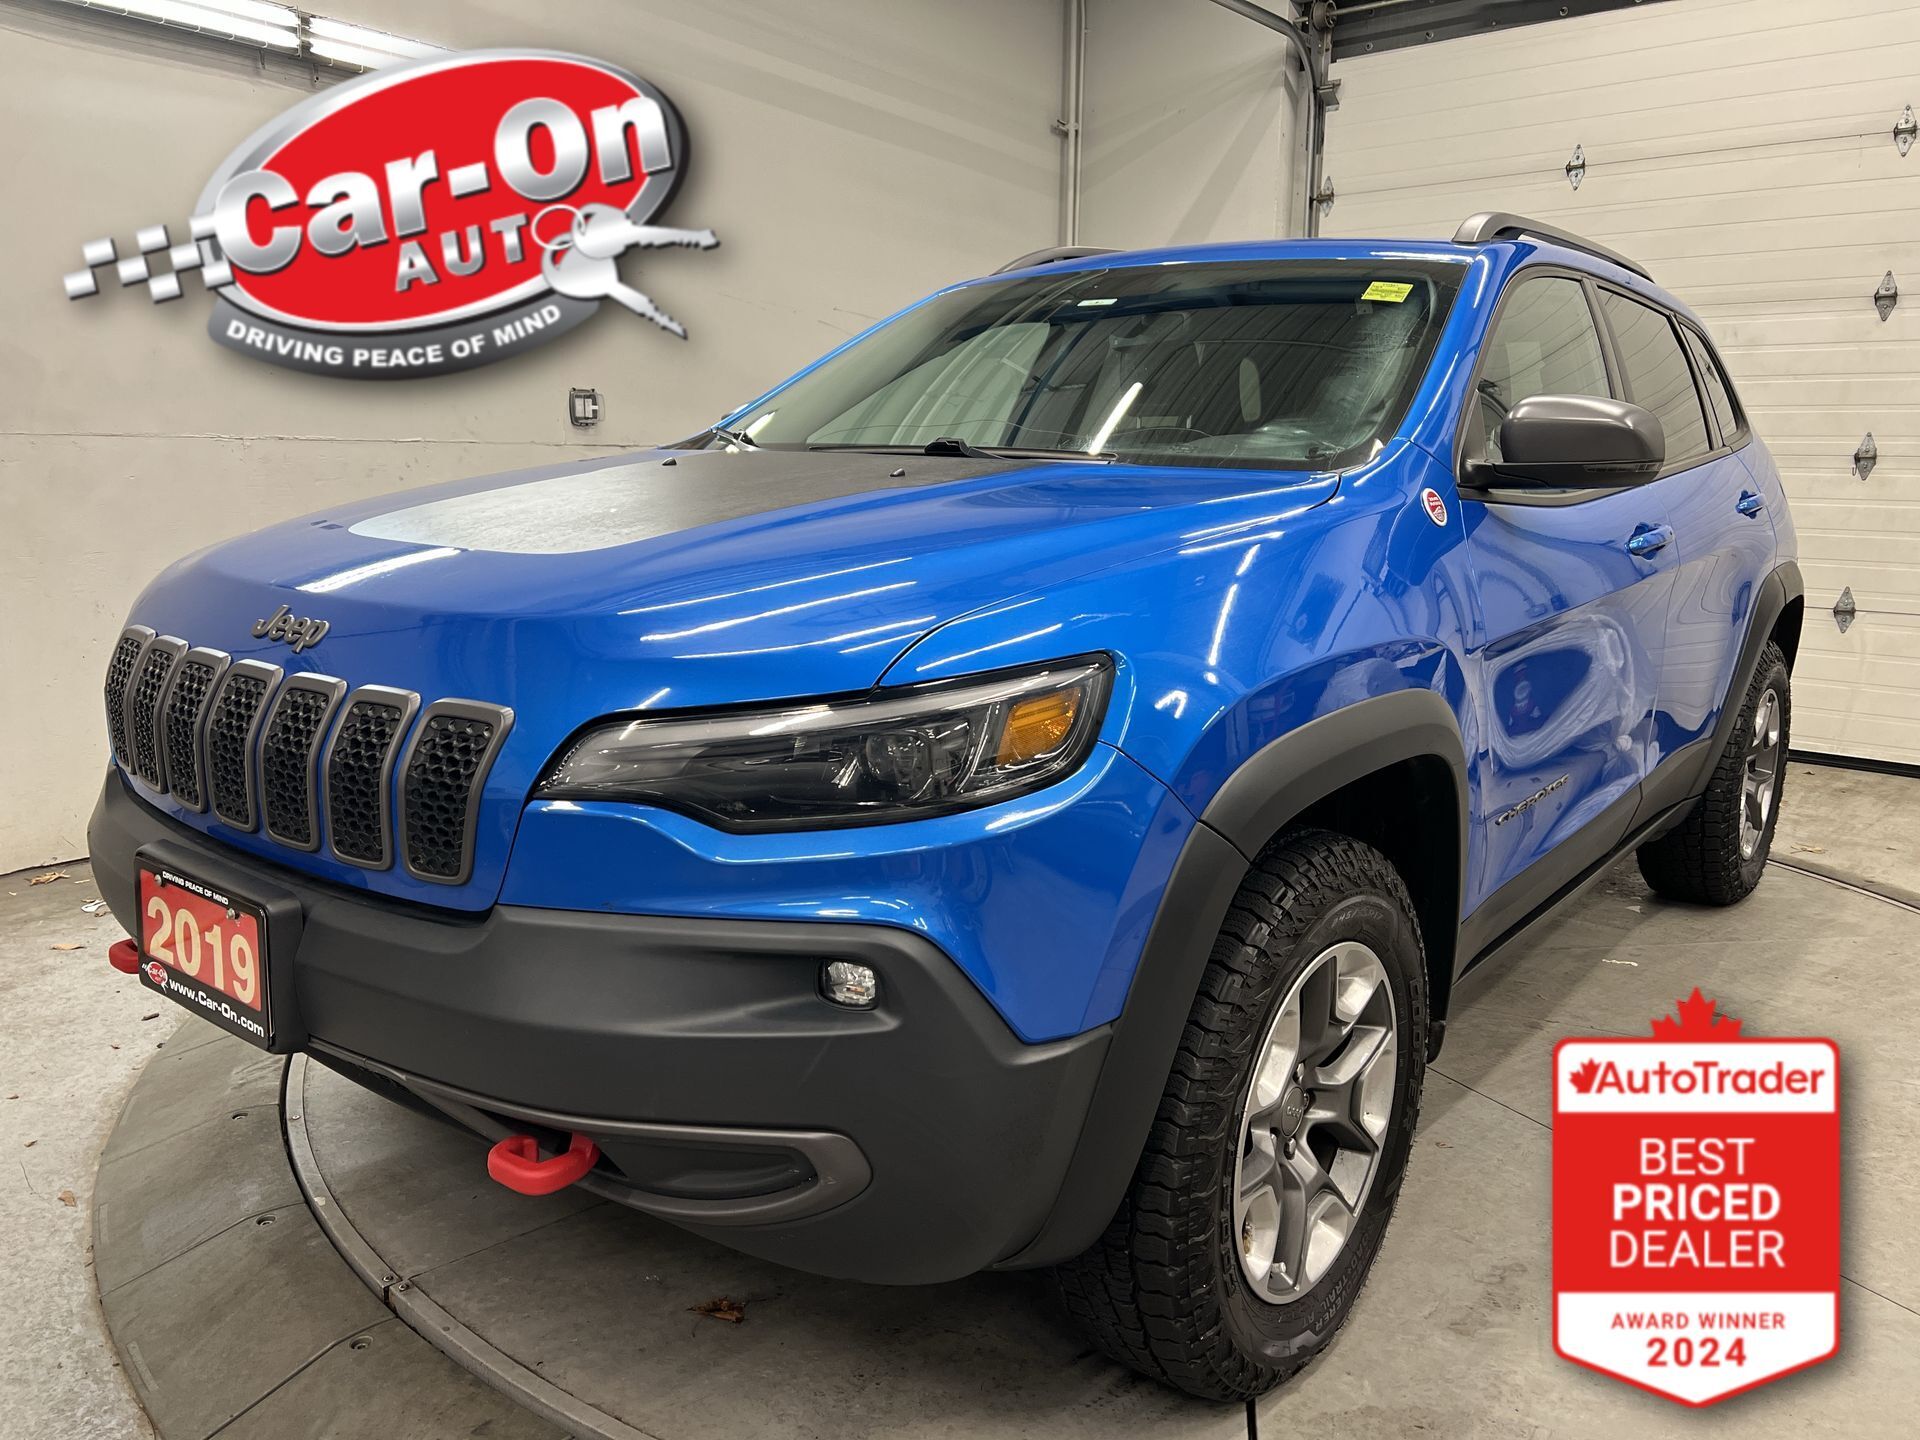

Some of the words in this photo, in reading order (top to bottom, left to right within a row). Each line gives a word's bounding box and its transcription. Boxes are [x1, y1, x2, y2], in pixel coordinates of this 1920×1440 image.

[251, 604, 331, 654] Jeep
[162, 870, 185, 886] DRIVING
[185, 880, 204, 895] PEACE
[204, 888, 213, 898] OF
[212, 892, 229, 906] MIND
[147, 896, 256, 1004] 2019
[169, 978, 265, 1038] www.Car-On.com
